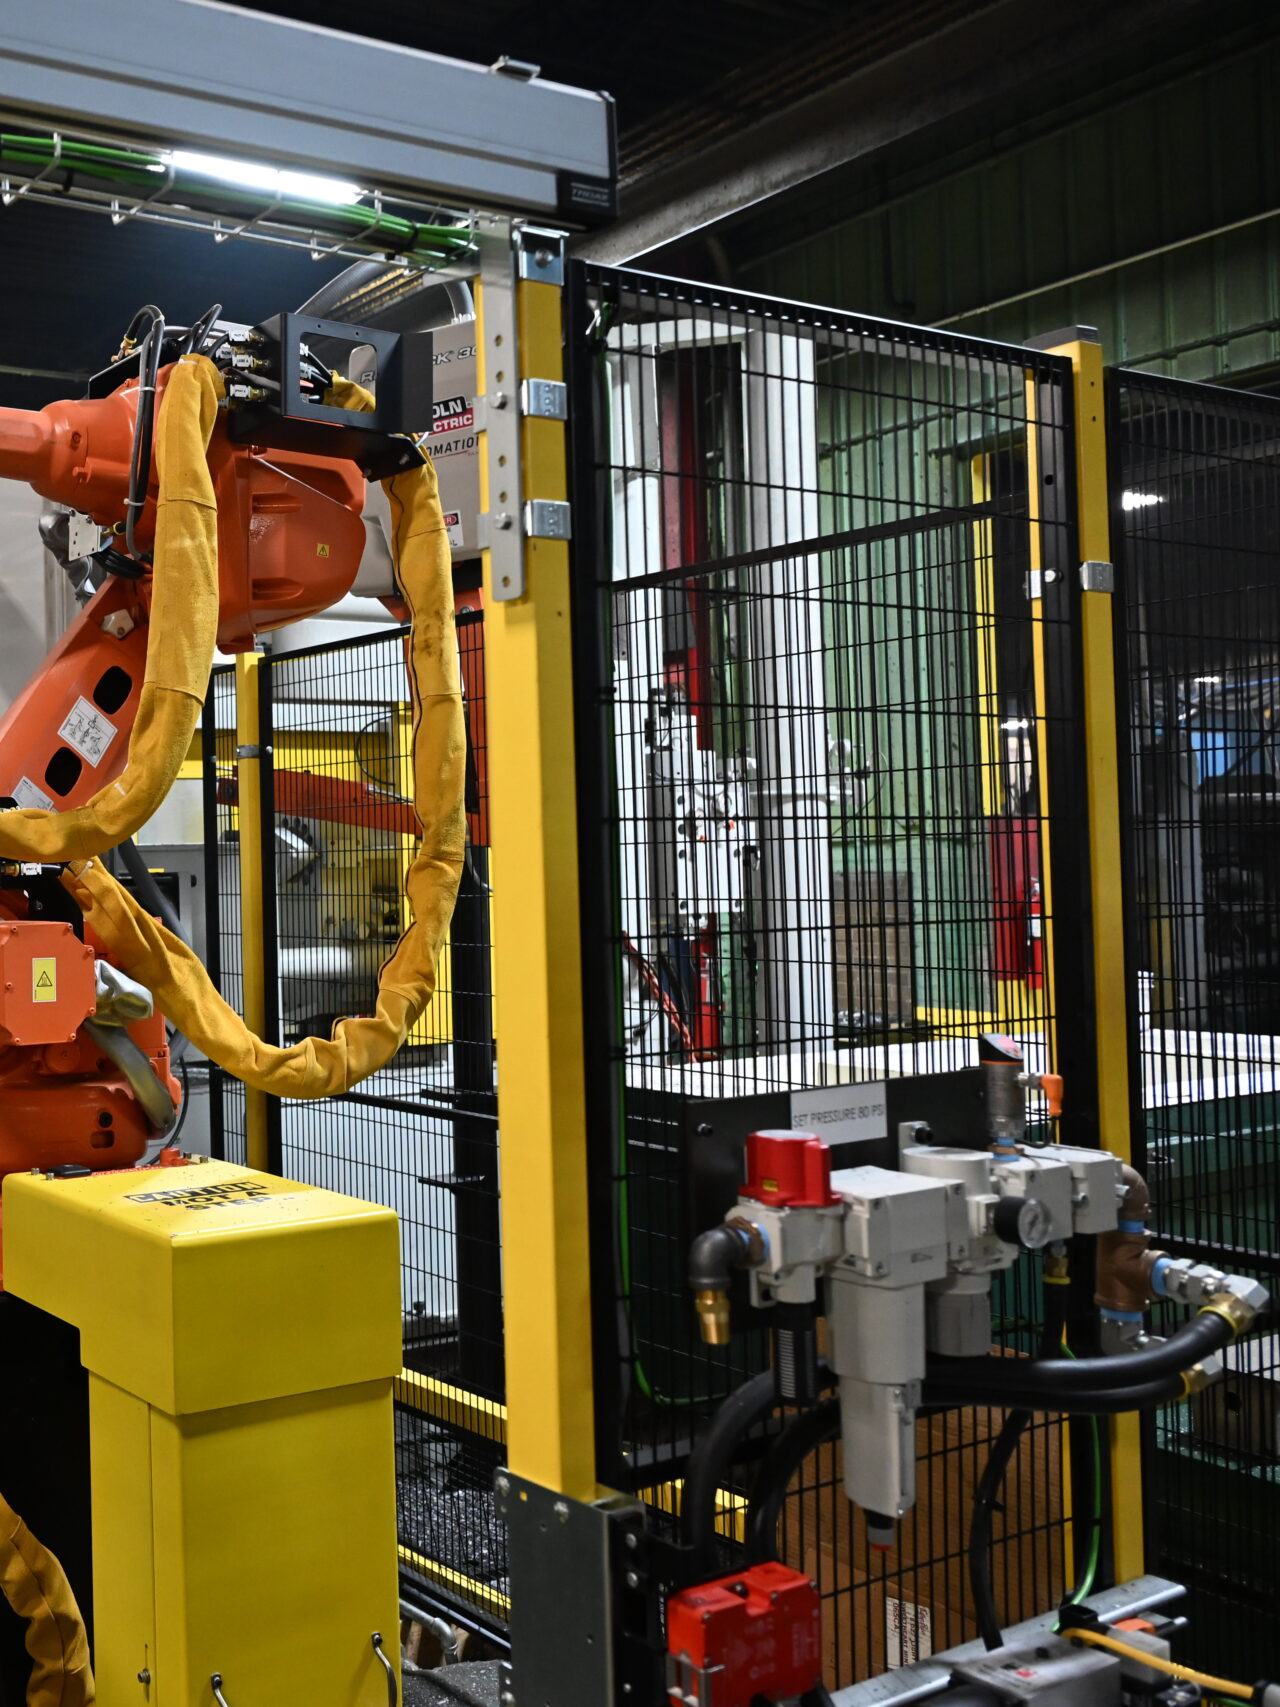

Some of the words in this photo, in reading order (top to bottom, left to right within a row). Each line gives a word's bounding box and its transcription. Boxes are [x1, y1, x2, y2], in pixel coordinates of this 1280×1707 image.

[433, 399, 463, 418] OLN
[433, 414, 473, 432] CTRIC
[128, 1181, 265, 1203] CAUTION
[245, 1190, 269, 1198] A
[185, 1196, 273, 1211] STEP
